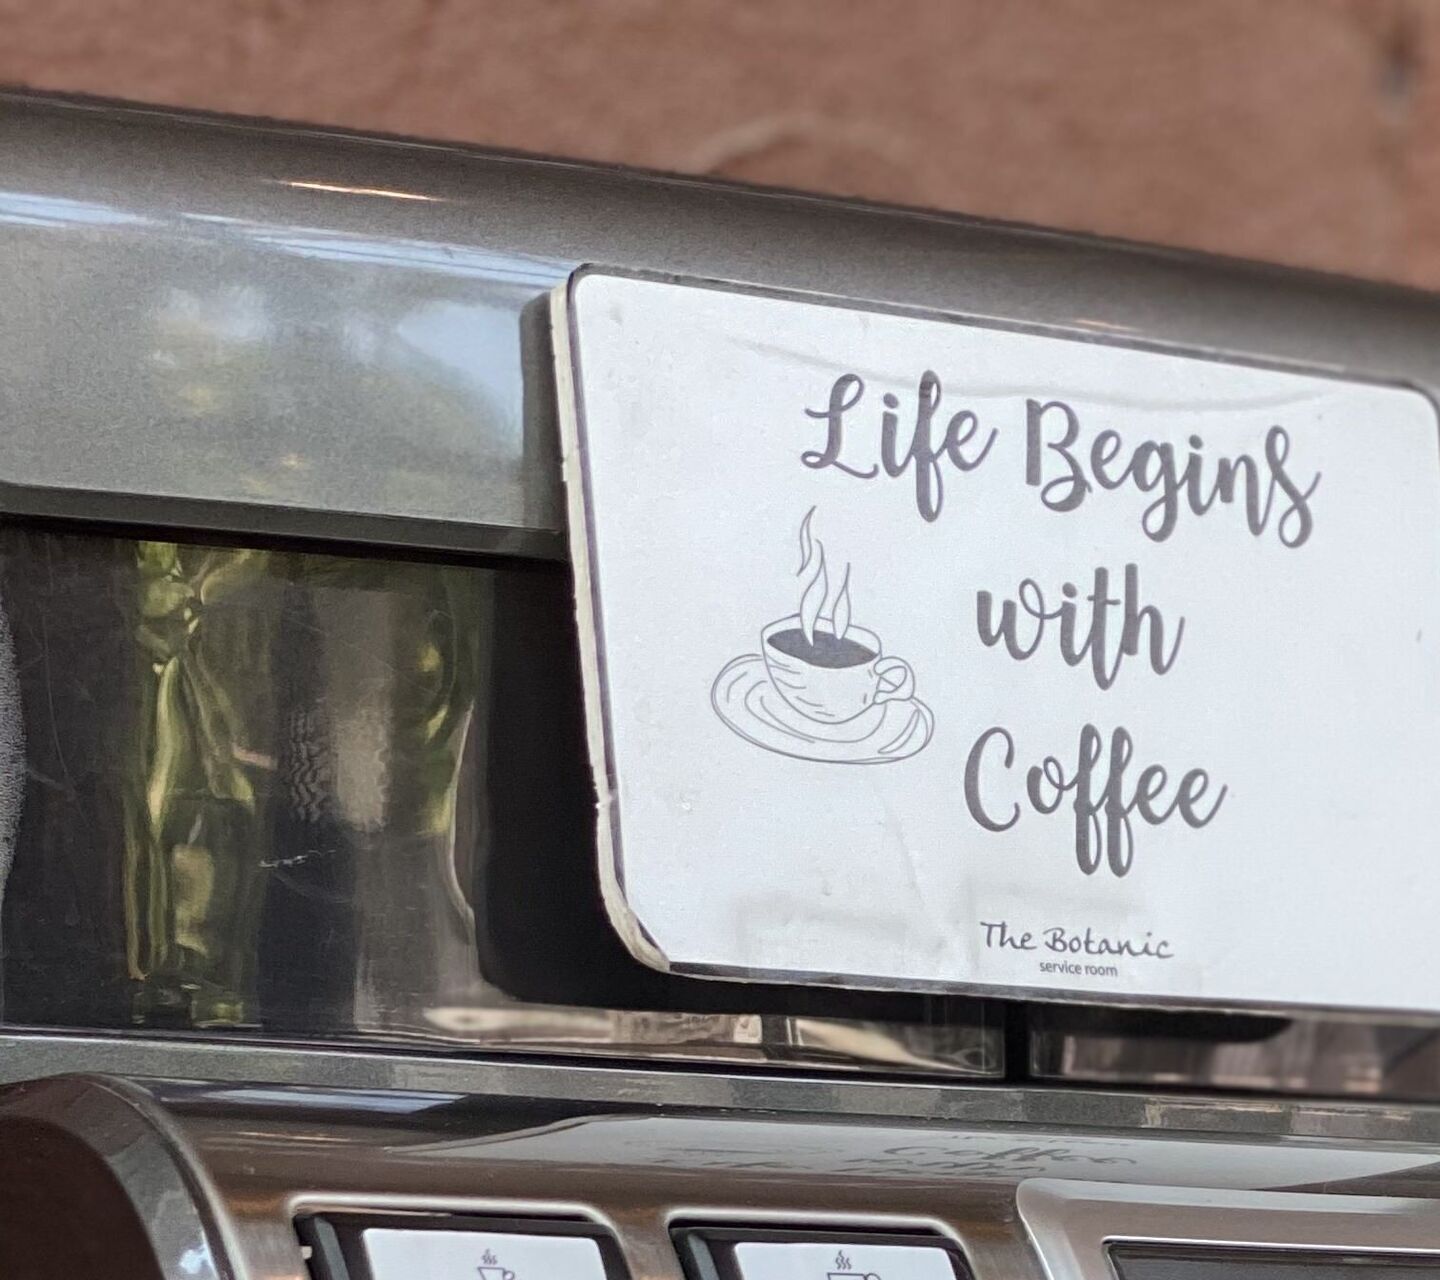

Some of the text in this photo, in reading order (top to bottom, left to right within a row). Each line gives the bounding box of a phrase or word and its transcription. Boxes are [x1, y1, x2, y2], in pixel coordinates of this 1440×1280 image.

[799, 369, 1321, 549] Life Begins
[976, 563, 1185, 691] with
[963, 723, 1228, 878] Coffee
[980, 921, 1174, 959] The Botanic
[1039, 960, 1119, 978] service room
